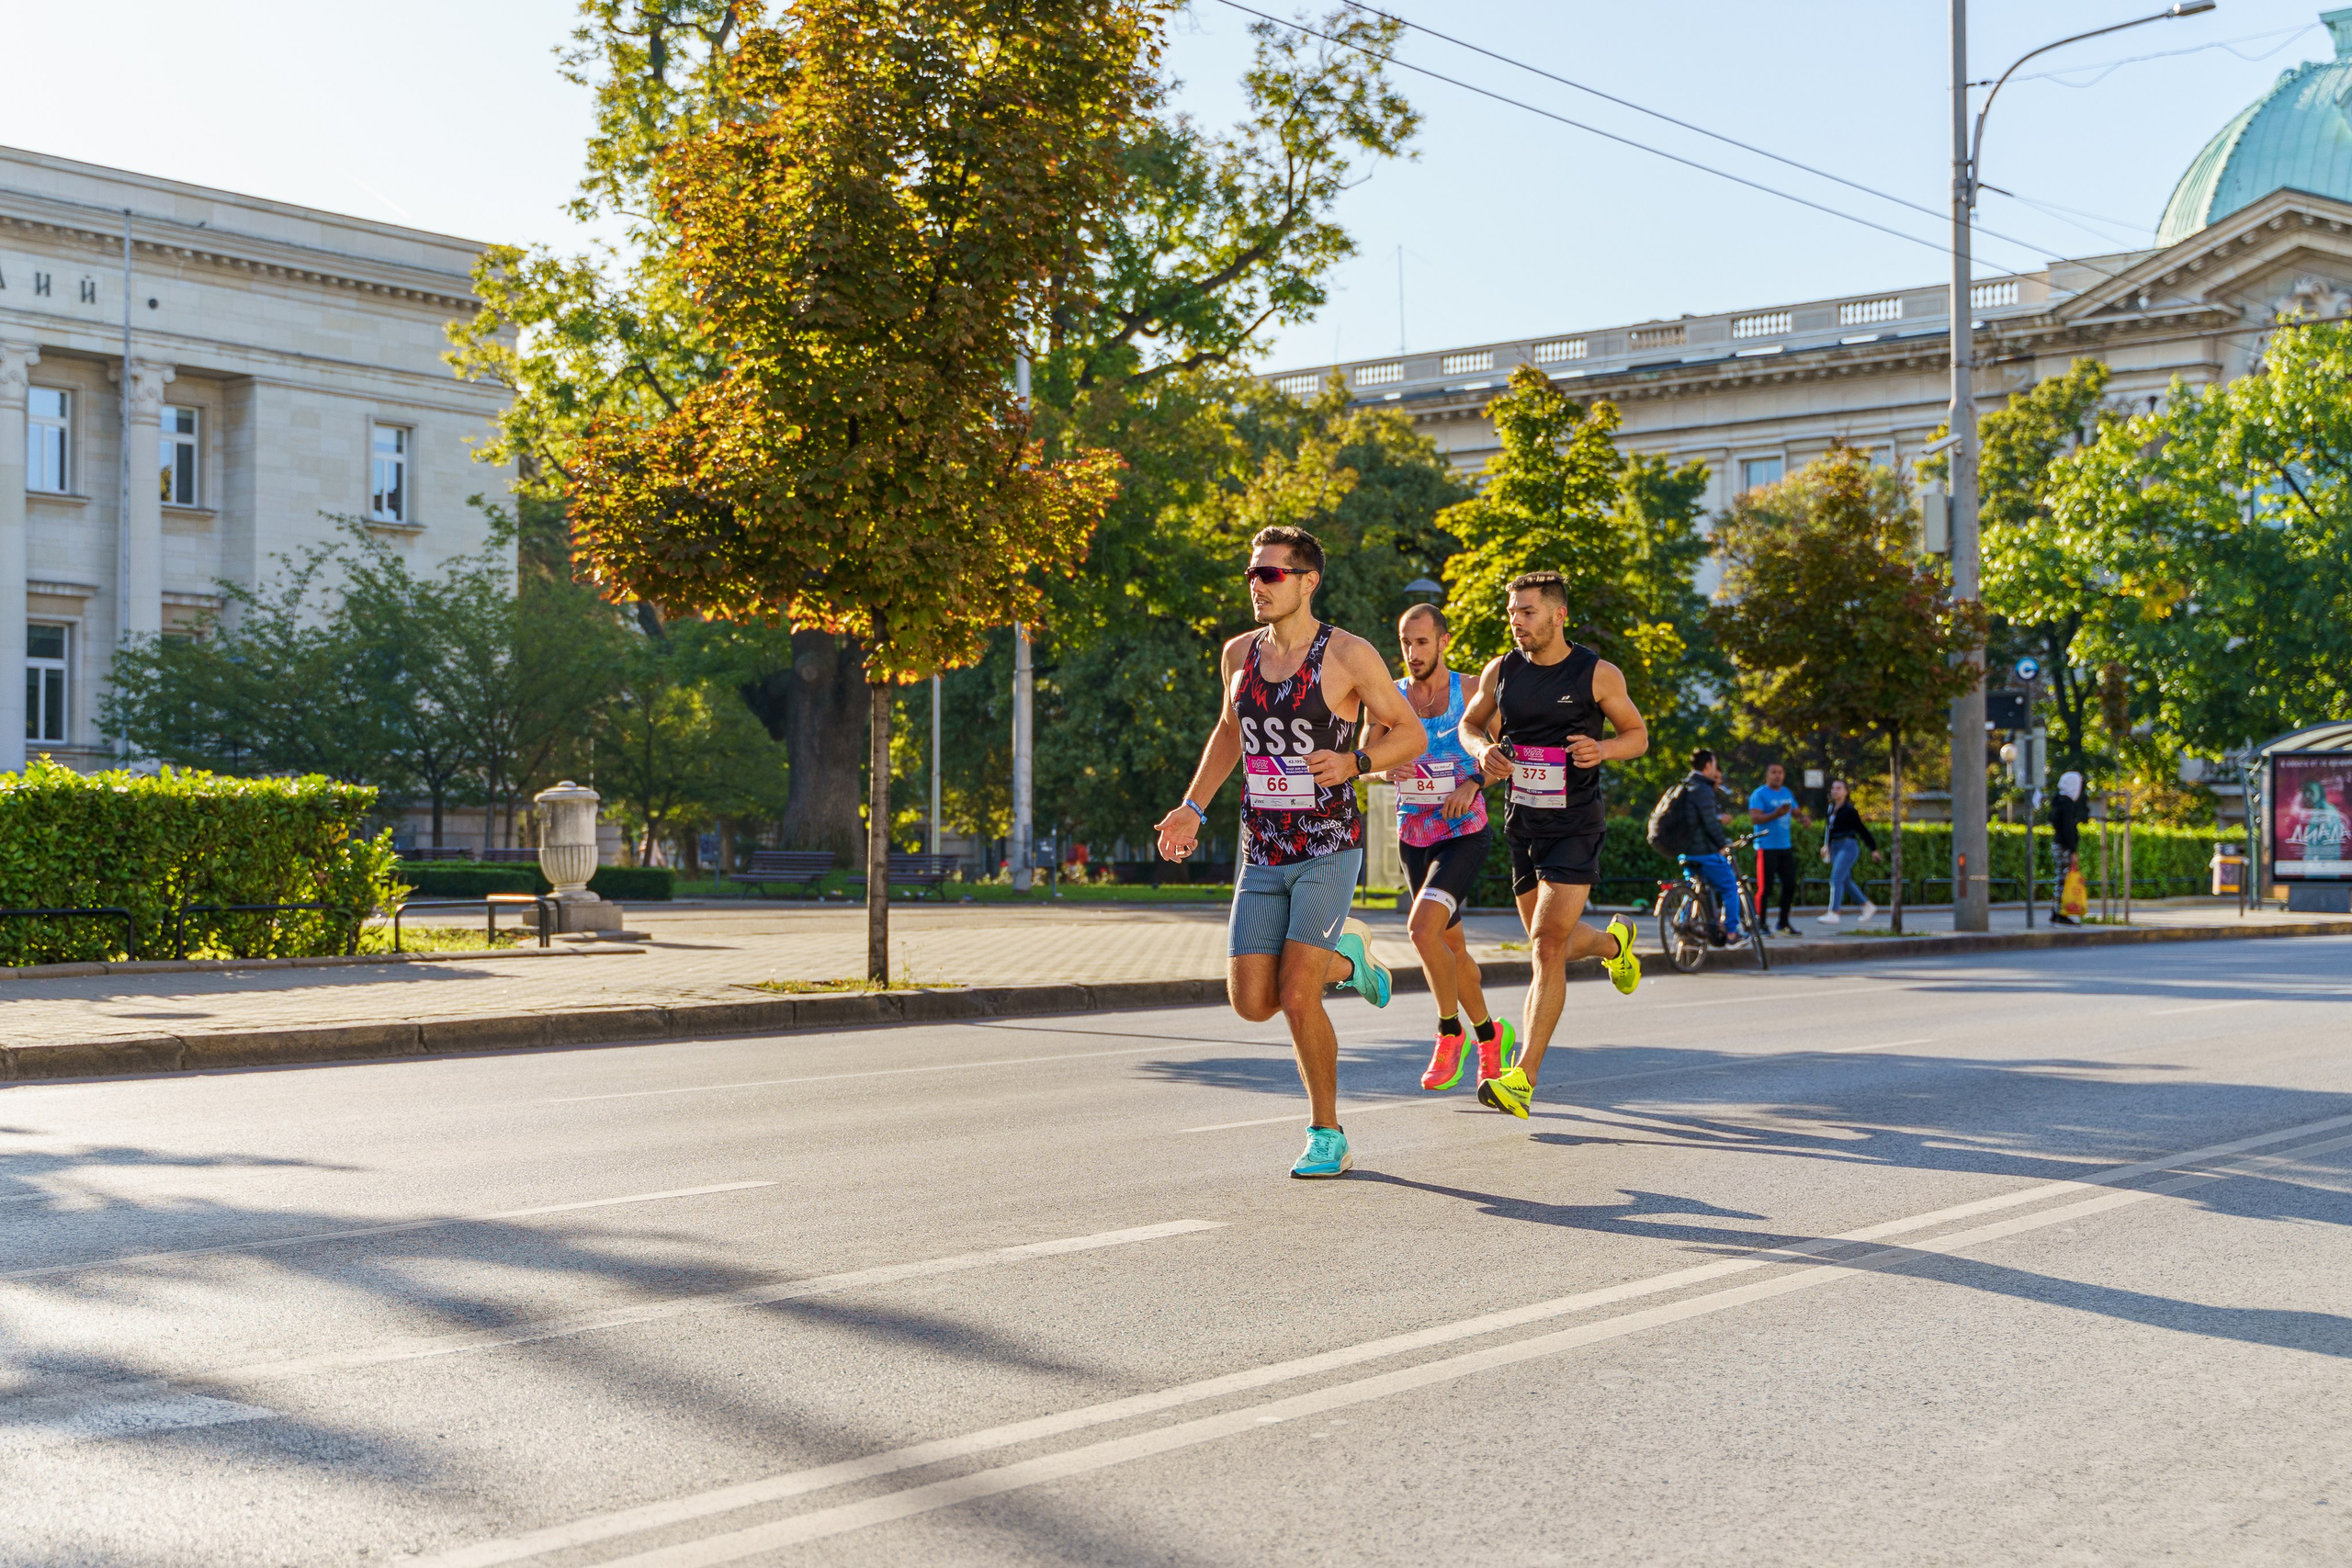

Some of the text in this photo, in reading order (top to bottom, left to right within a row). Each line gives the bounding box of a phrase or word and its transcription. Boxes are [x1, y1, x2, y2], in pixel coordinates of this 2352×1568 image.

[0, 267, 96, 305] ИЙ
[1241, 716, 1315, 755] SSS
[1522, 767, 1546, 781] 373
[1267, 777, 1288, 792] 66
[1417, 780, 1435, 791] 84
